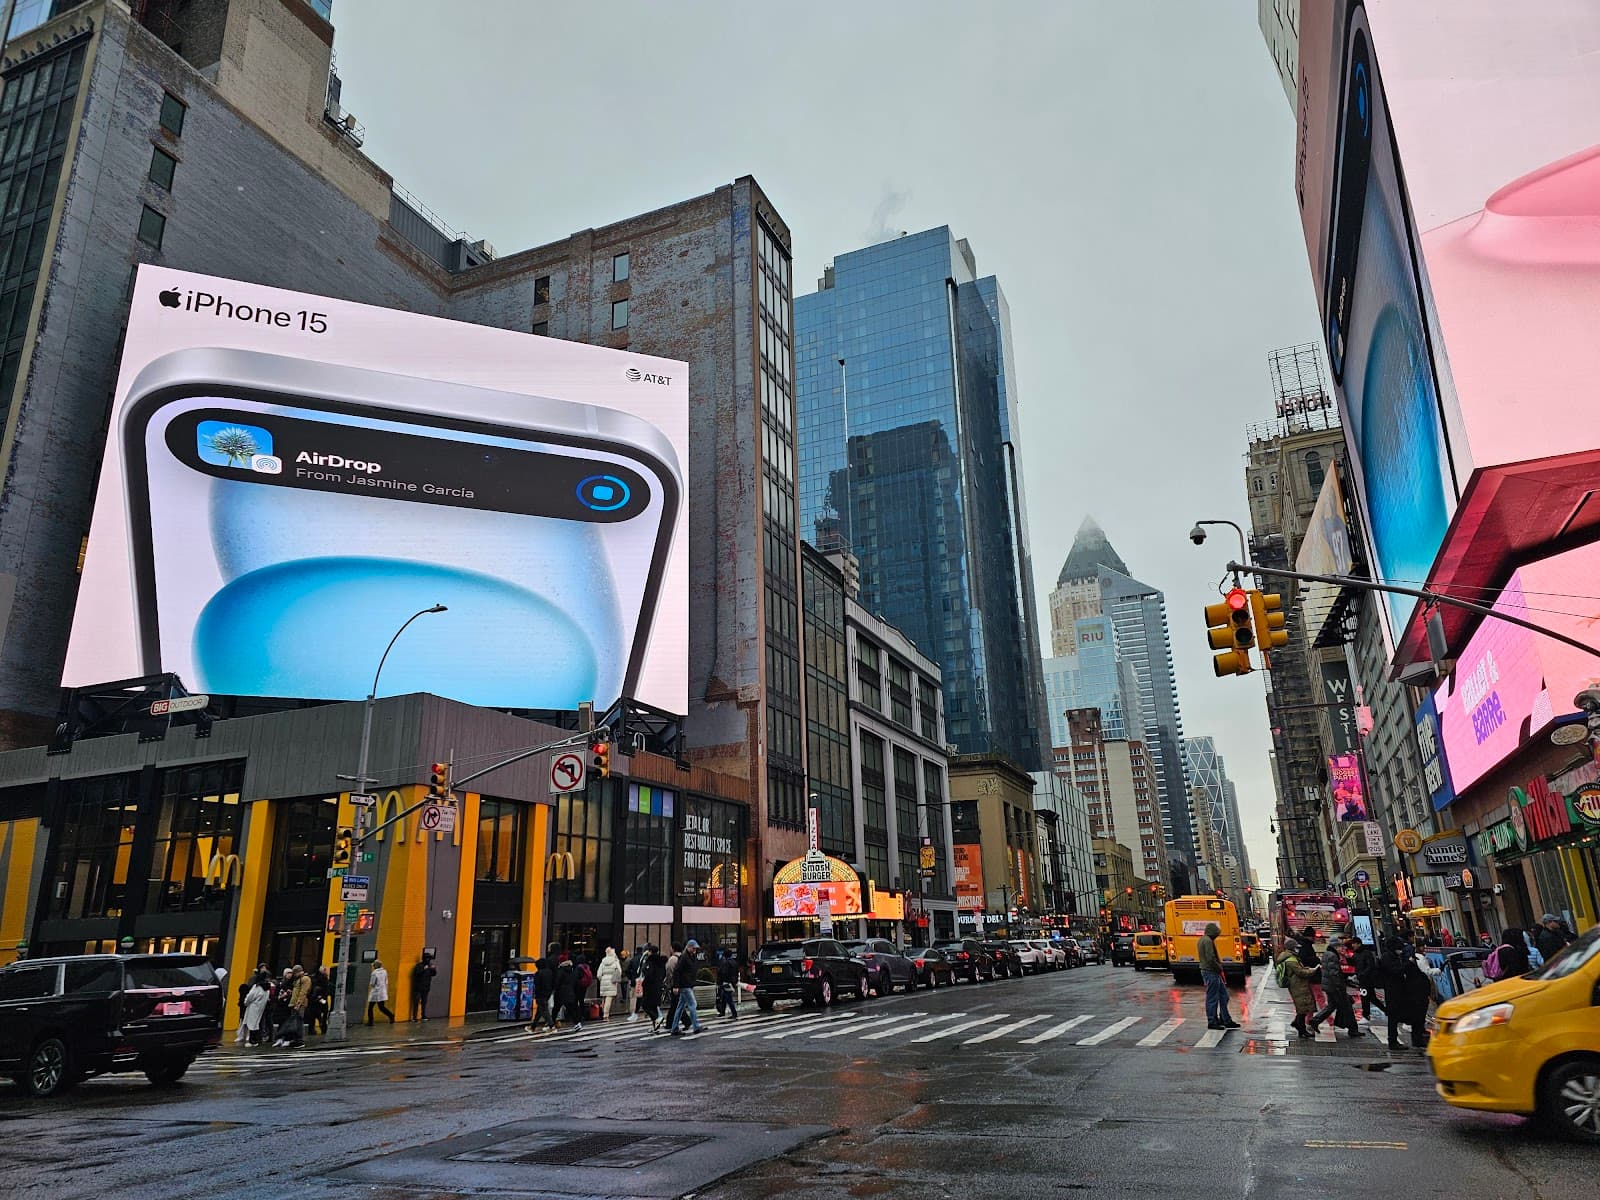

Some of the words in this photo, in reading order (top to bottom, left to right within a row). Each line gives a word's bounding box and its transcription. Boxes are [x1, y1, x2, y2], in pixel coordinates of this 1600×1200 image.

[186, 290, 291, 327] iPhone
[297, 310, 328, 334] 15
[643, 373, 672, 386] AT&T
[296, 451, 382, 474] AirDrop
[296, 468, 341, 483] From
[346, 474, 417, 492] Jasmine
[422, 483, 475, 499] Garcia
[1081, 632, 1104, 643] RIU
[153, 702, 168, 712] BIG
[1327, 679, 1352, 754] WESTI
[685, 815, 702, 832] RETAL
[1426, 845, 1465, 856] Auntie
[1427, 853, 1466, 864] Anne's
[802, 871, 831, 880] BURGER
